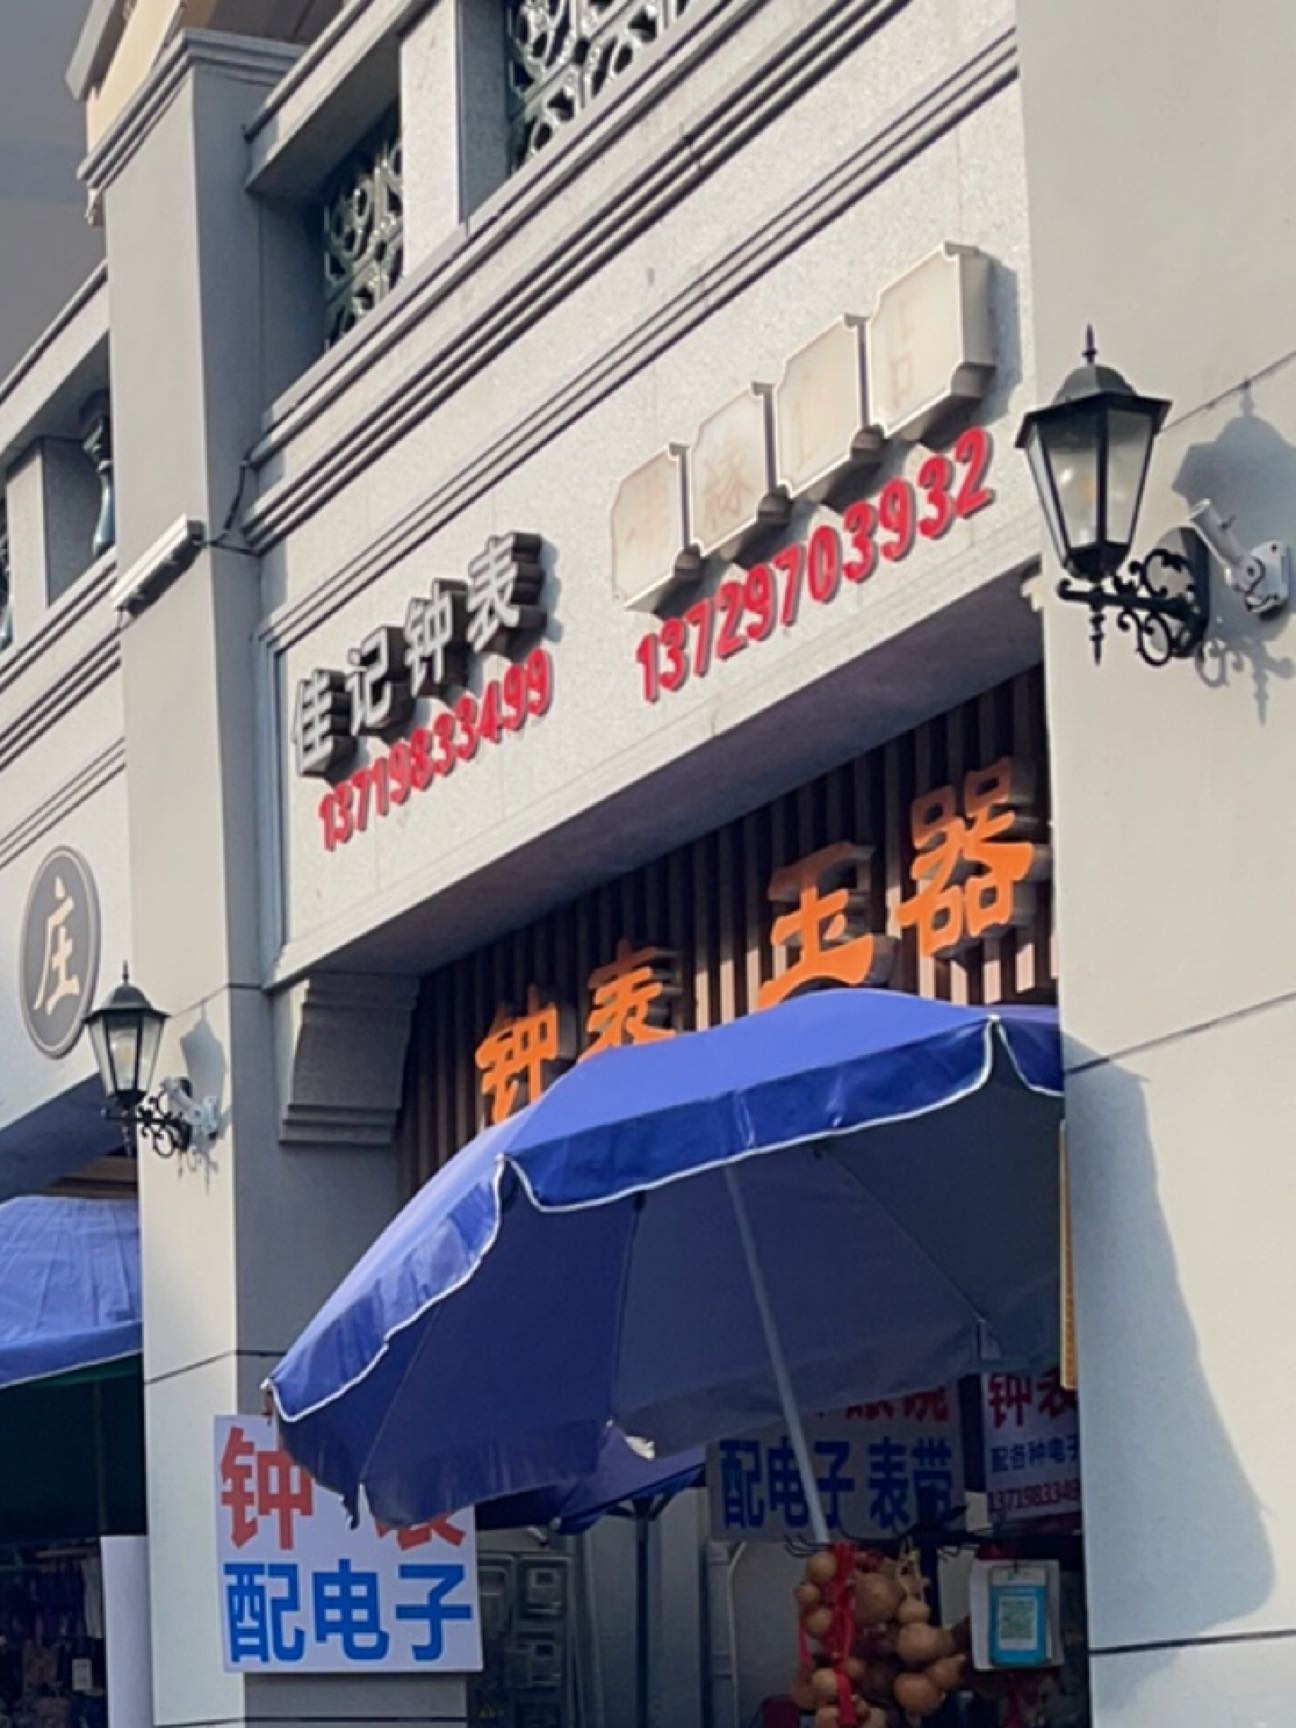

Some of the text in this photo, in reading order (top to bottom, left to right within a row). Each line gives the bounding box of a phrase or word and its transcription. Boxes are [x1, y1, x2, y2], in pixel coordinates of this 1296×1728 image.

[292, 531, 534, 777] 佳记钟表
[635, 426, 993, 702] 13729703932
[318, 647, 552, 852] 13719833499
[223, 1558, 472, 1663] 配电子
